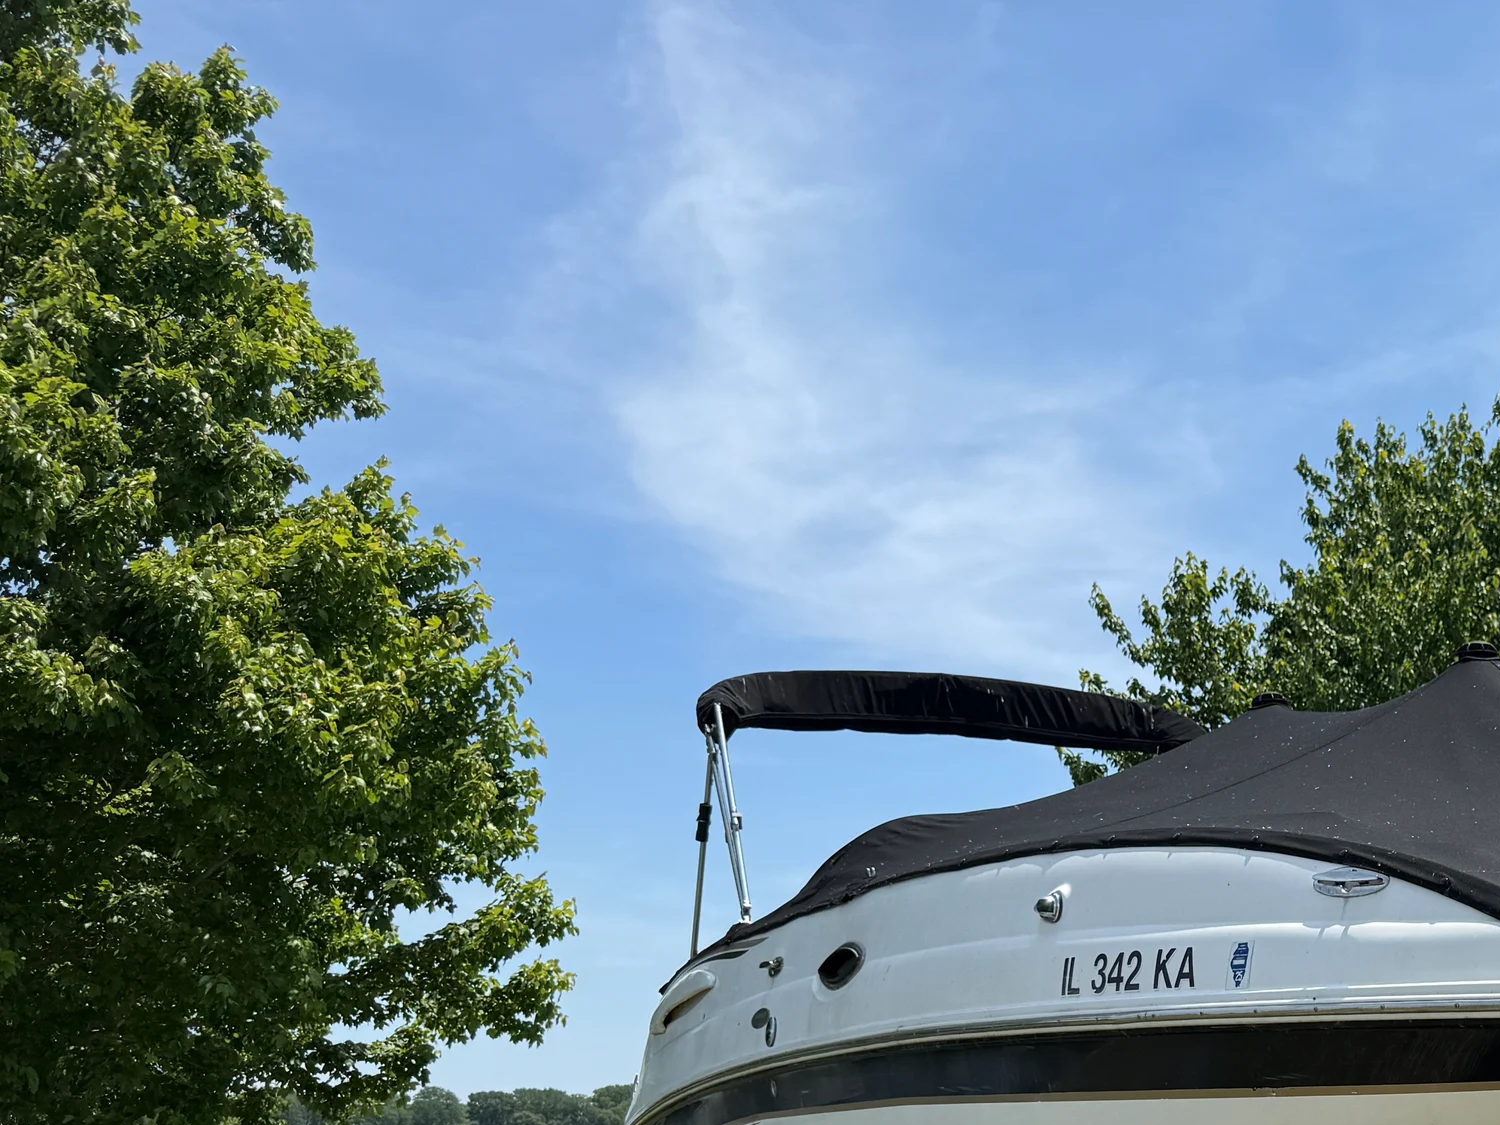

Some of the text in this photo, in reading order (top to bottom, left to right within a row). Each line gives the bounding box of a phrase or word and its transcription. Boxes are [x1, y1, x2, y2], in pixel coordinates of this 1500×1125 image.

[1061, 957, 1080, 996] IL
[1091, 951, 1142, 994] 342
[1153, 947, 1195, 989] KA
